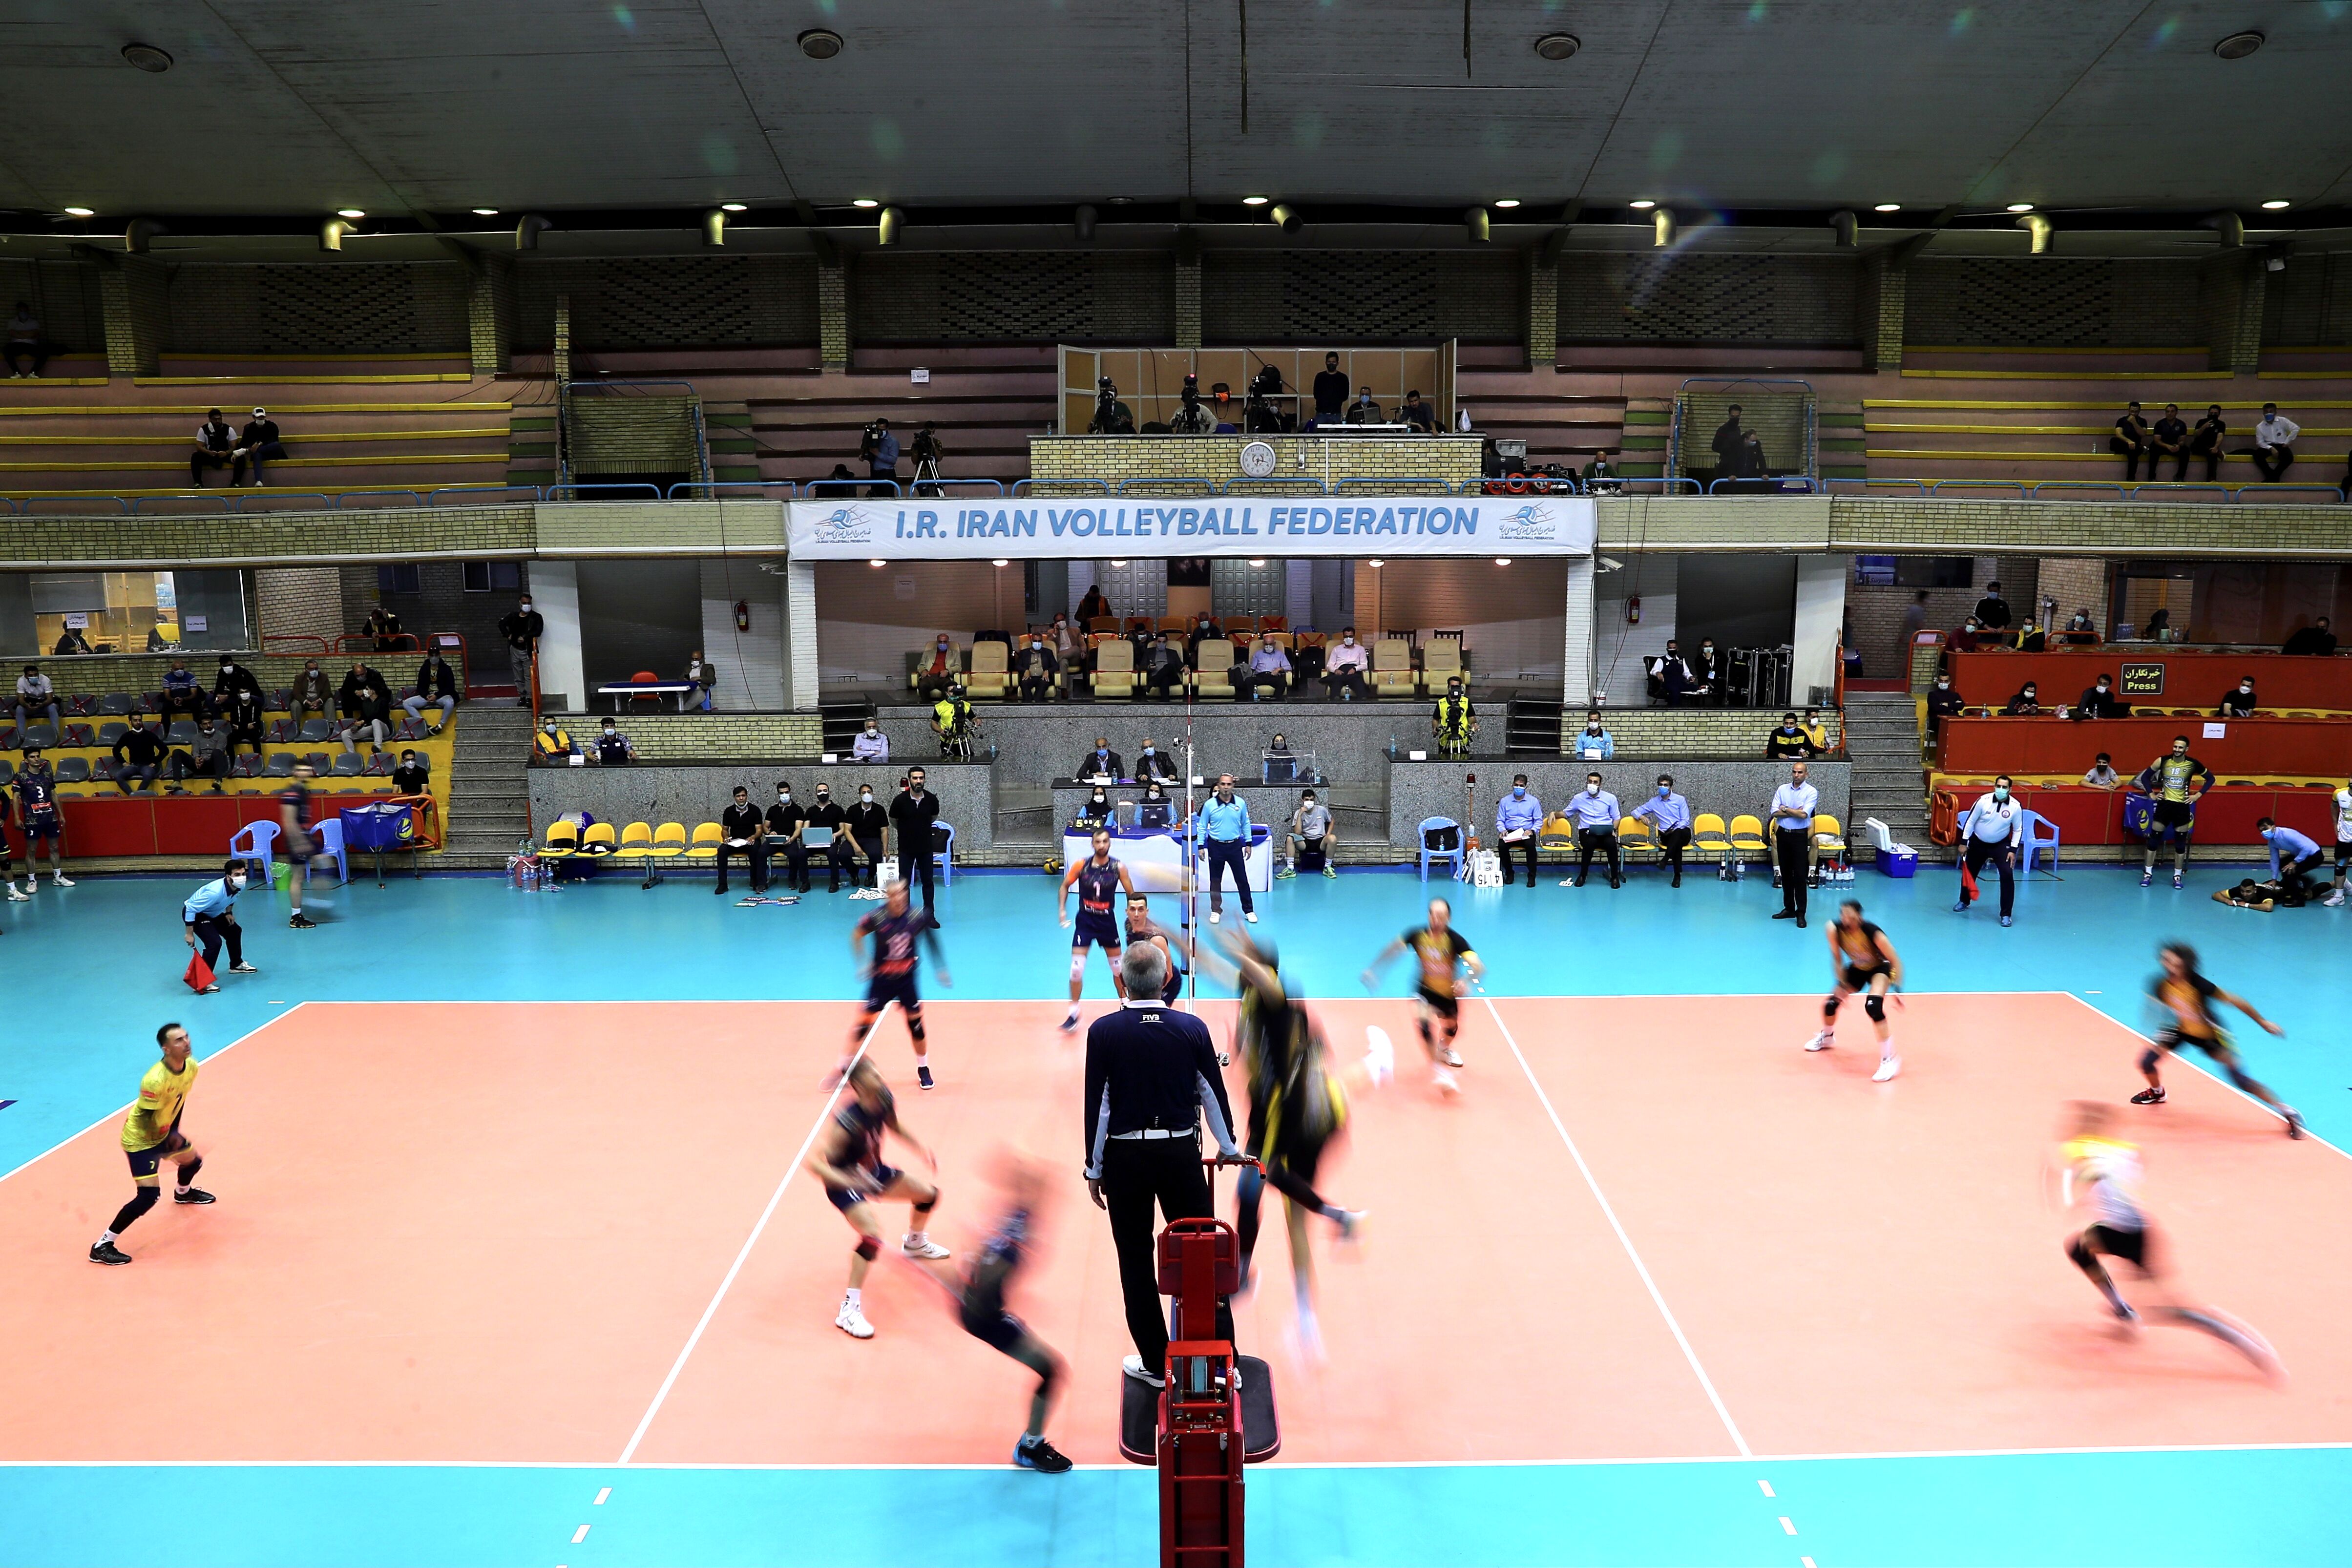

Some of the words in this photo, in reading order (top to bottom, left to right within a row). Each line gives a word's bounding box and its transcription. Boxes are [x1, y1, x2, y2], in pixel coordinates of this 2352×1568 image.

[896, 510, 946, 537] I.R.
[957, 509, 1038, 537] IRAN
[1048, 507, 1259, 536] VOLLEYBALL
[1268, 506, 1479, 534] FEDERATION
[2125, 669, 2161, 679] خبرنگاران
[2127, 682, 2157, 690] Press
[36, 786, 44, 798] 3
[1076, 819, 1083, 828] 5
[1093, 820, 1101, 828] 4
[1478, 874, 1488, 885] 15
[1093, 881, 1100, 897] 1
[149, 1160, 155, 1170] 7
